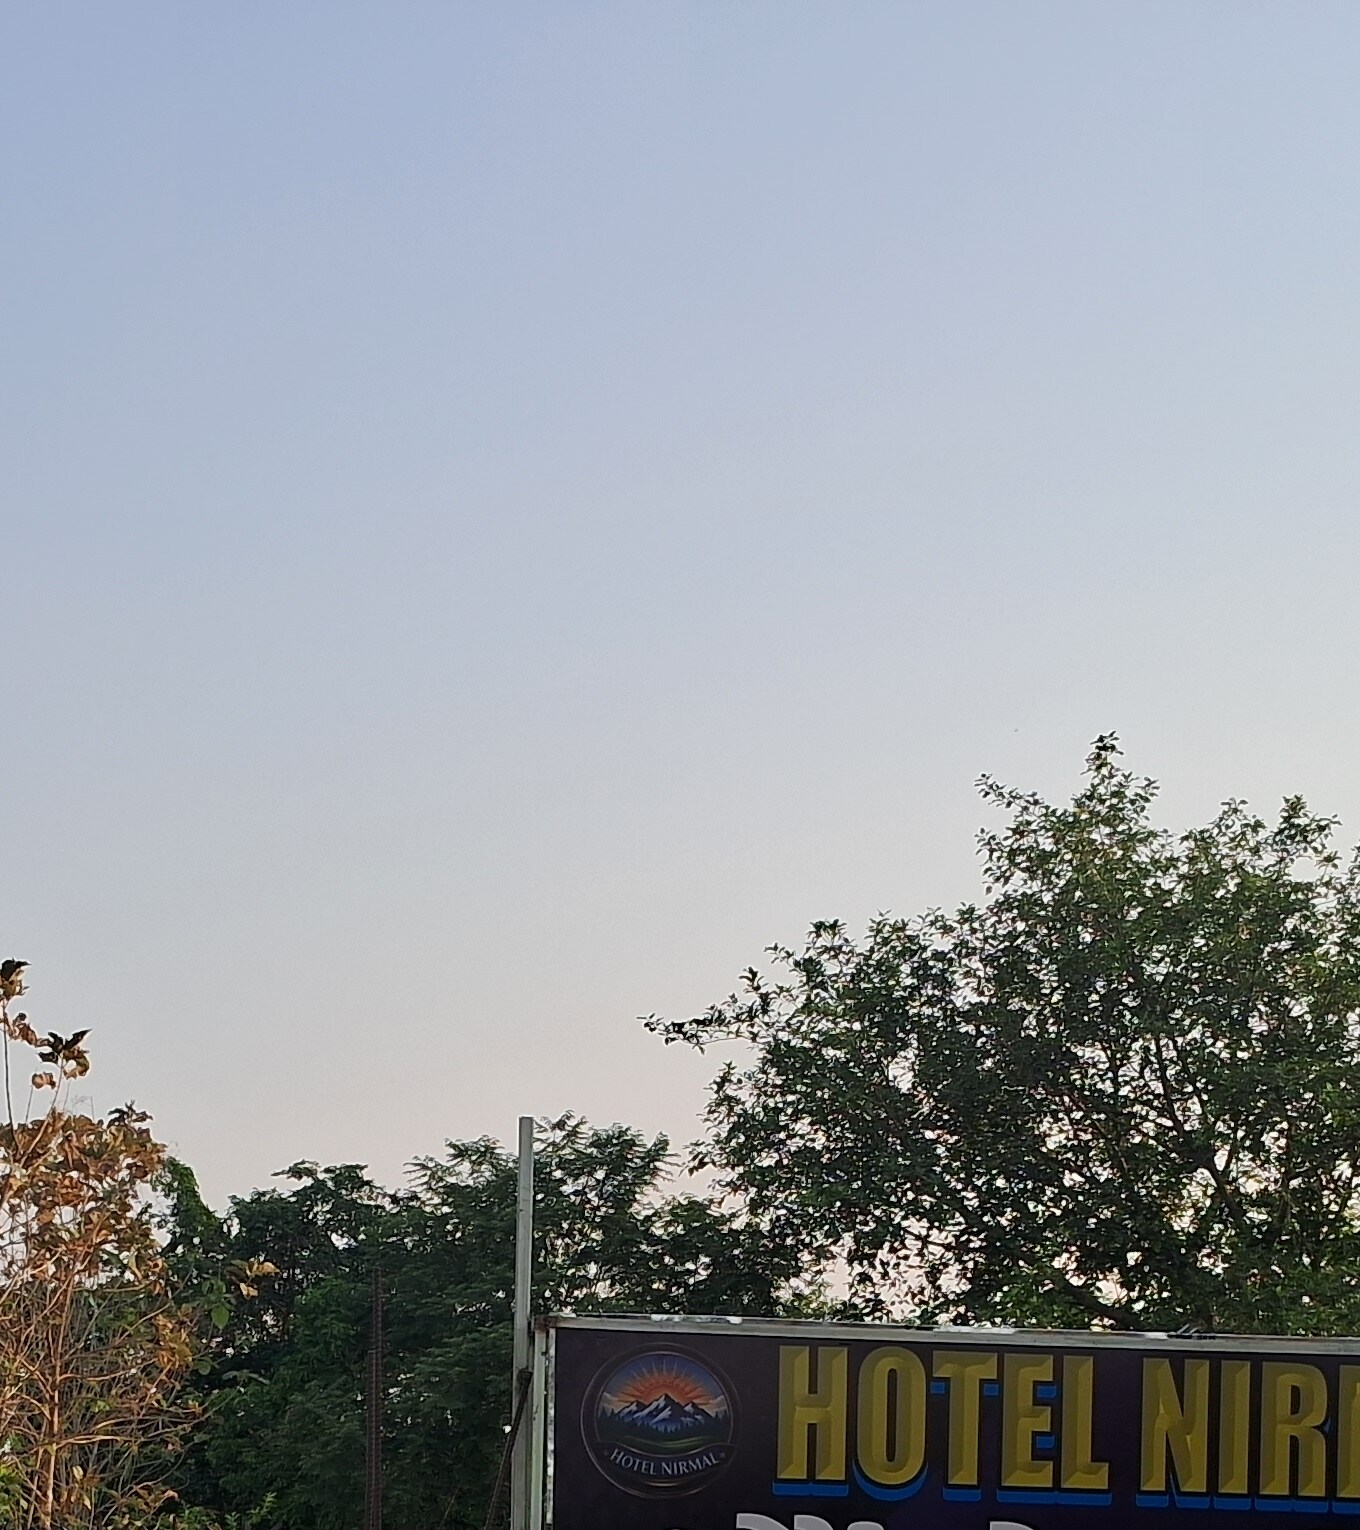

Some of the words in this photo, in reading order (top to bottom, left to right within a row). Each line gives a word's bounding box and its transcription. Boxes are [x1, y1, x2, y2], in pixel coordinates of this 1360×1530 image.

[610, 1448, 657, 1475] HOTEL
[661, 1452, 720, 1475] NIRMAL
[773, 1345, 1112, 1503] HOTEL
